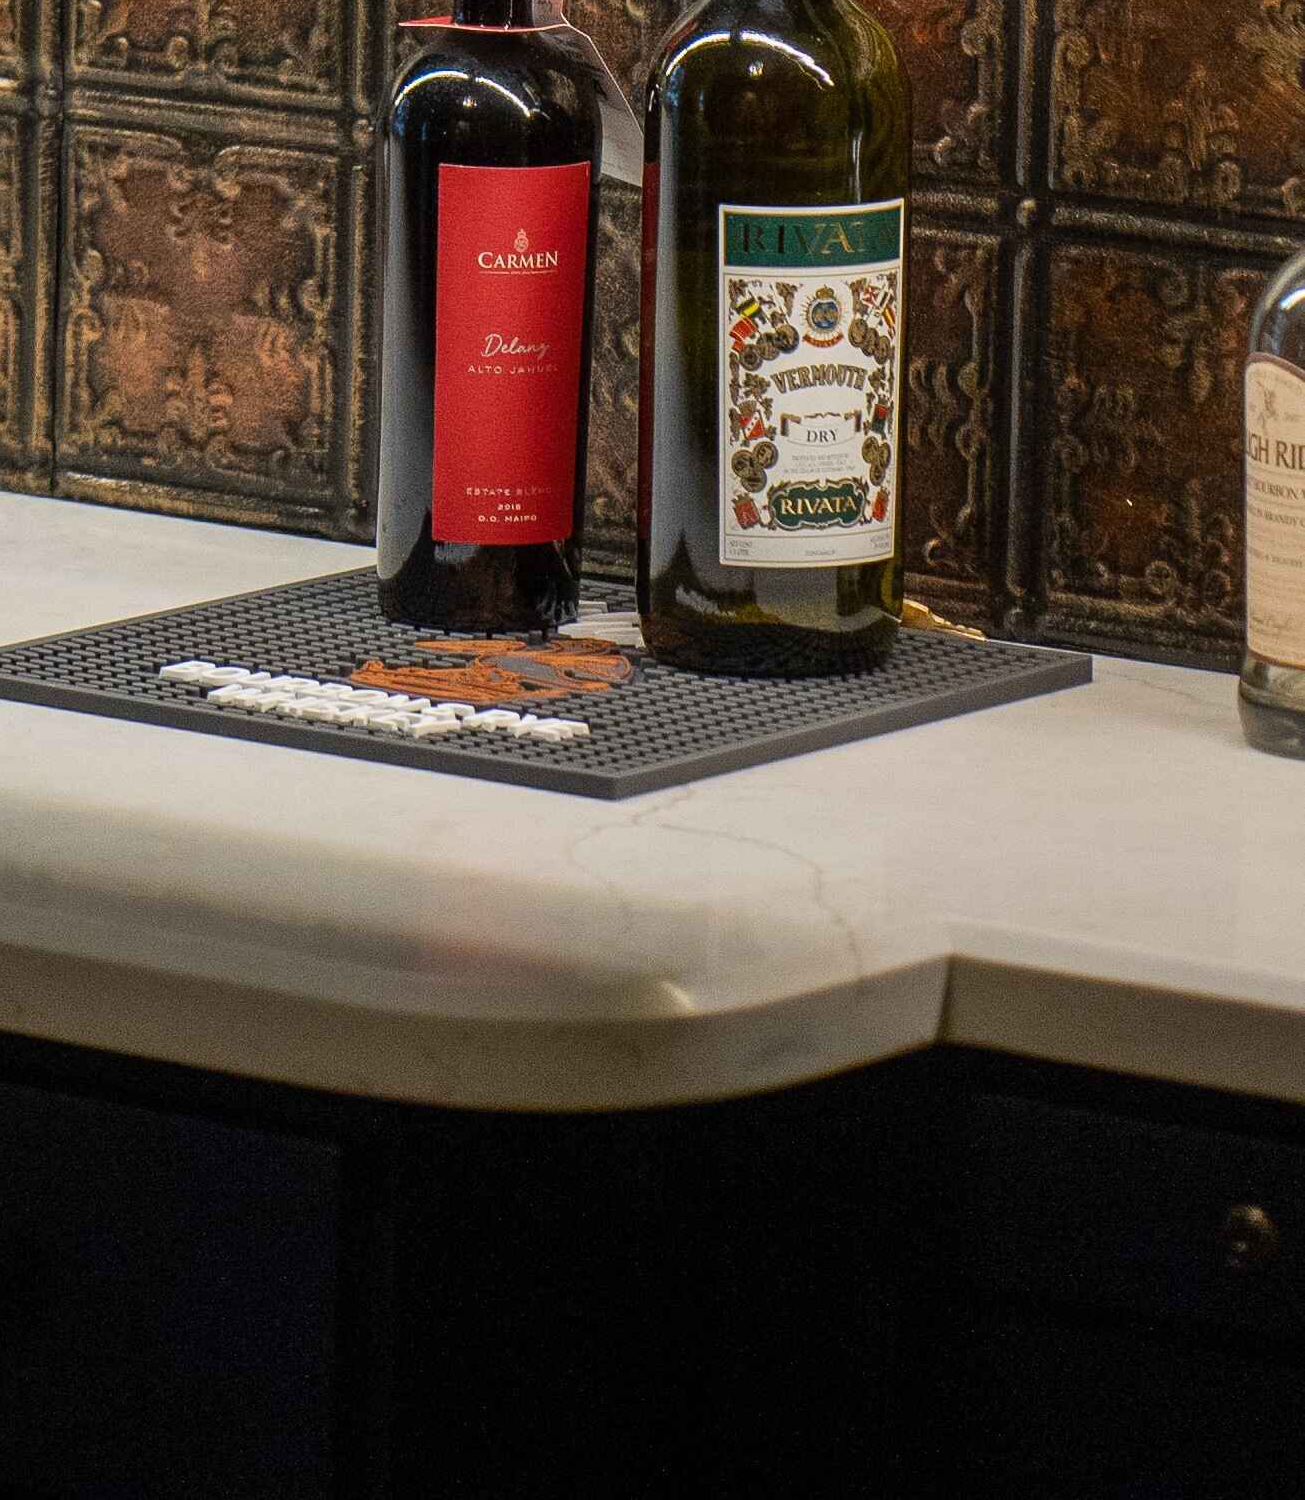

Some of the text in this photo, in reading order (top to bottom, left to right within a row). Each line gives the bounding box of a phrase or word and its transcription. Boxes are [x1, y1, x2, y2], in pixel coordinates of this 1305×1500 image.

[477, 250, 559, 270] CARMEN
[467, 363, 503, 375] ALTO
[769, 362, 869, 395] VERMOUTH
[805, 426, 841, 443] DRY
[466, 486, 511, 497] ESTATE
[779, 495, 859, 519] RIVATA
[504, 514, 538, 523] MAIPO
[158, 659, 433, 713] BOURBON
[461, 707, 591, 742] RYE
[206, 683, 463, 739] WHISKEY
